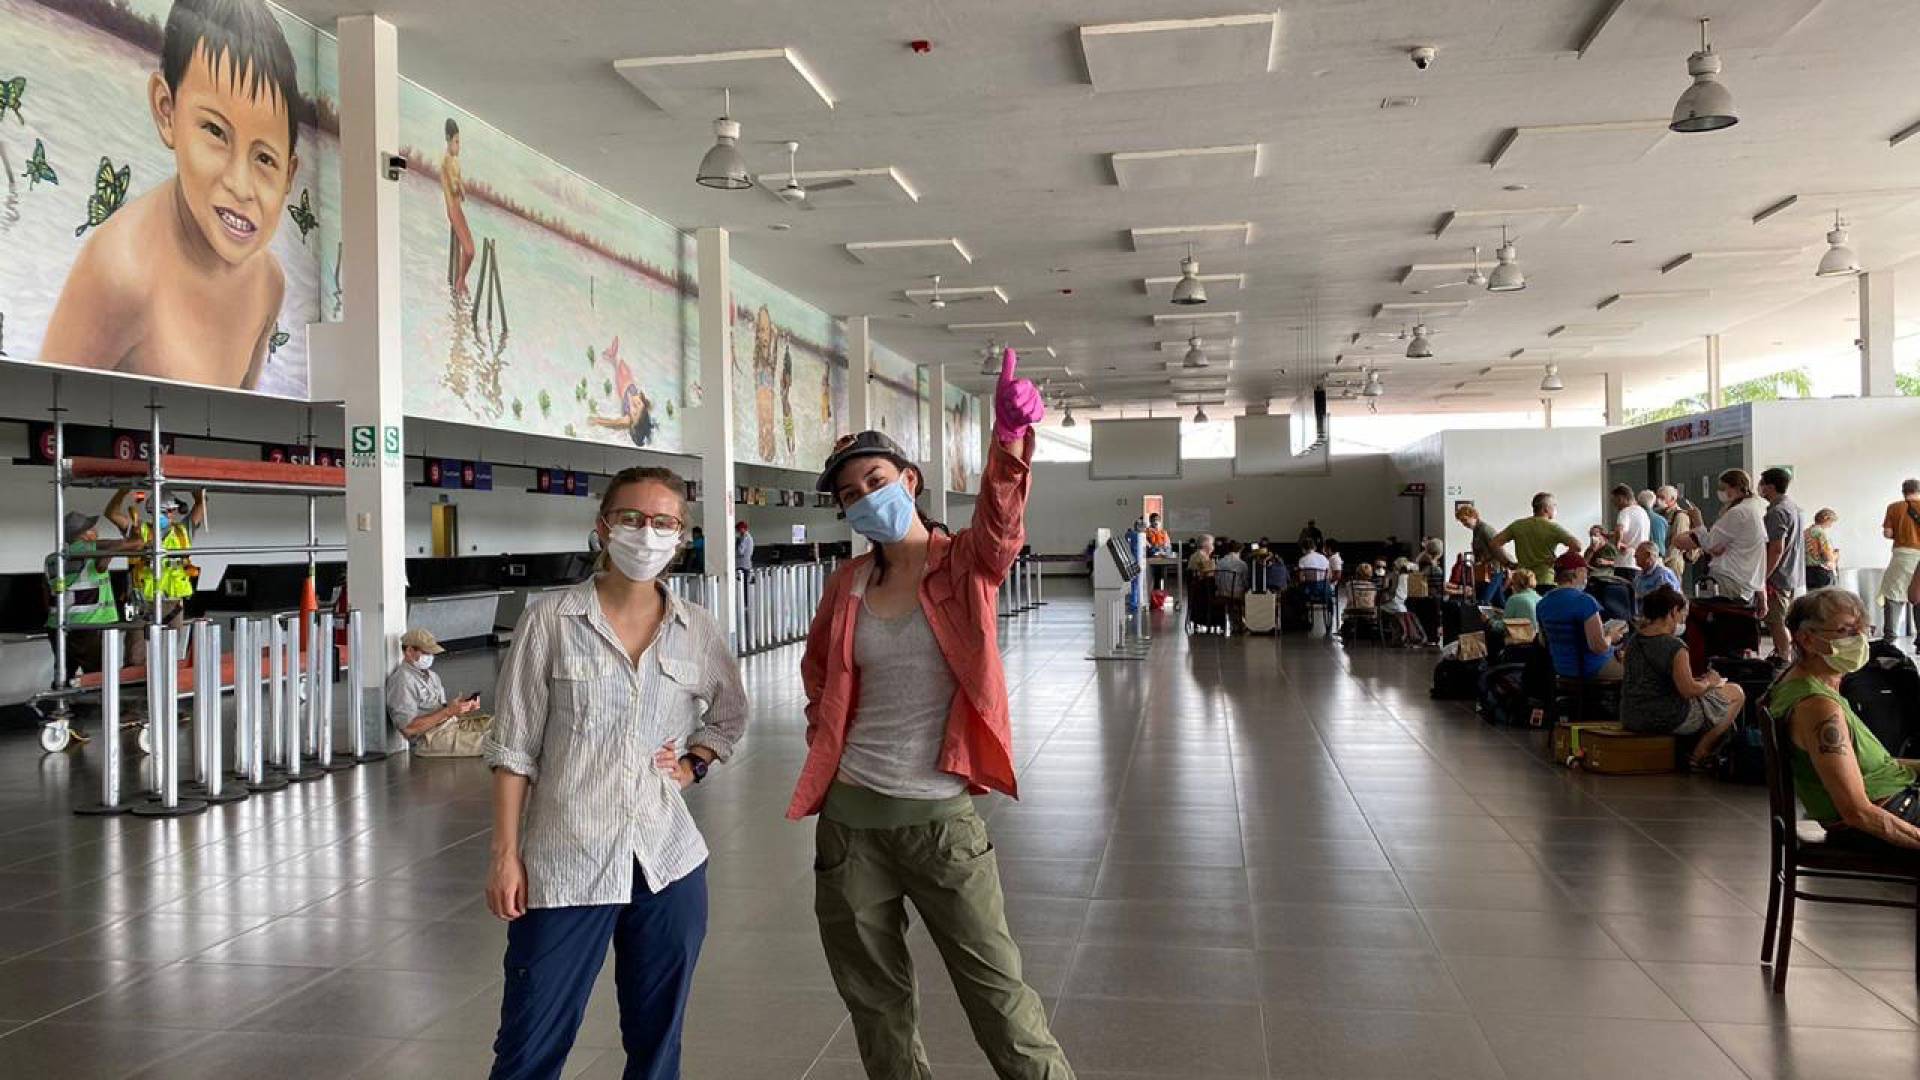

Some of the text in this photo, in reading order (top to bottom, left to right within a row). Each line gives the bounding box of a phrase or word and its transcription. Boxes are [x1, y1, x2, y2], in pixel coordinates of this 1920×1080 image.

[119, 440, 130, 460] 6
[355, 428, 373, 451] S
[386, 428, 397, 451] S
